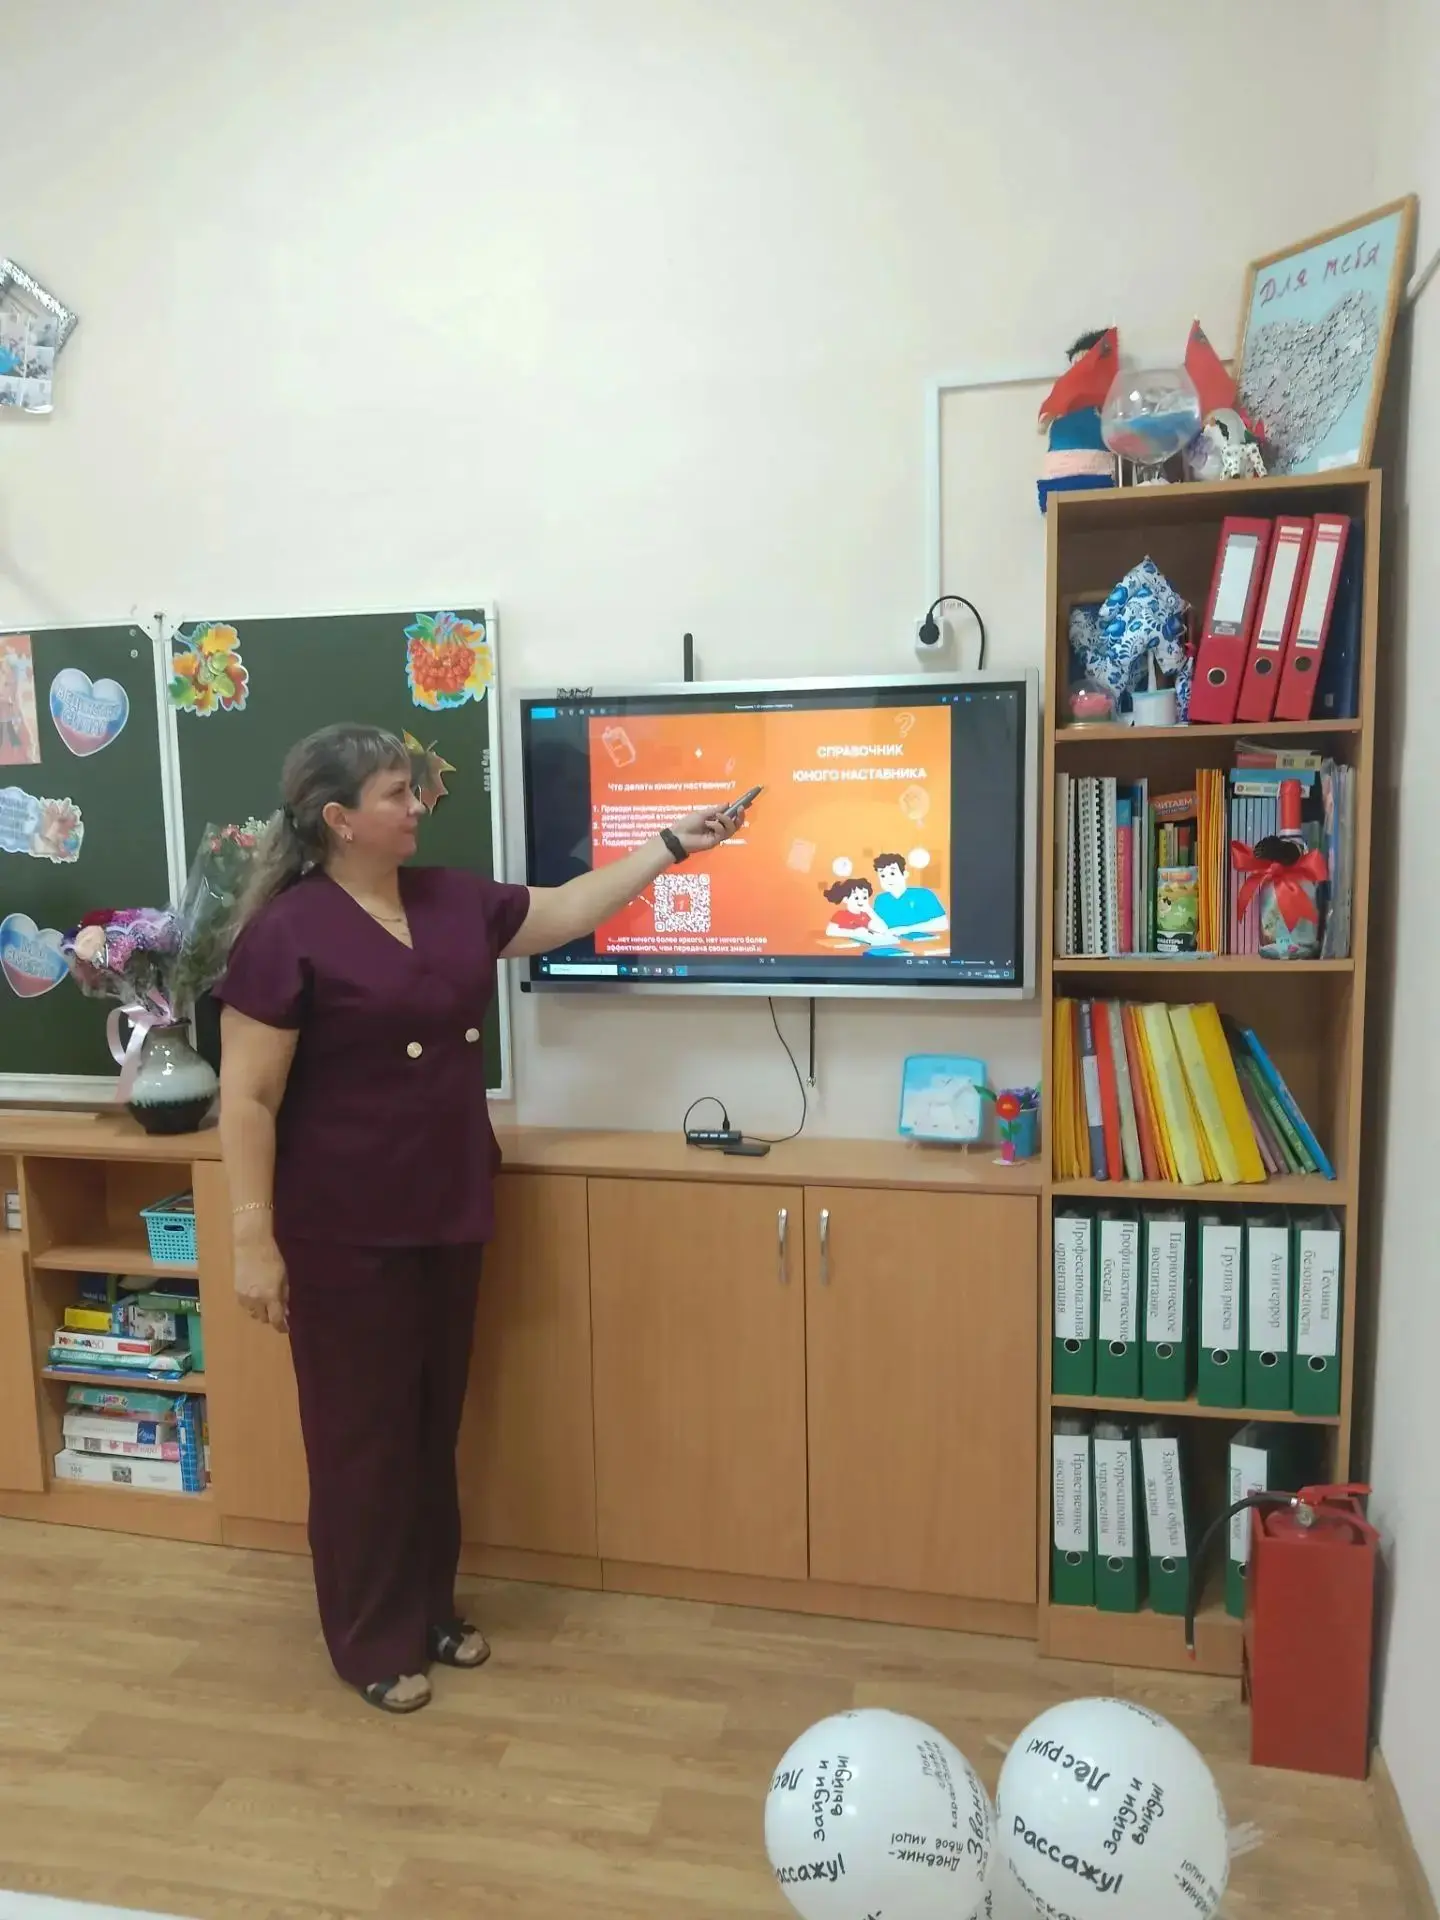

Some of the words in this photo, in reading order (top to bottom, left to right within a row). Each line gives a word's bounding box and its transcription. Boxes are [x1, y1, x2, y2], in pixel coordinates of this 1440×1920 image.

[792, 769, 839, 782] ЮНОГО
[841, 767, 928, 781] НАСТАВНИКА
[816, 744, 904, 758] СПРАВОЧНИК
[608, 782, 623, 792] Что
[624, 782, 653, 791] делать
[654, 781, 682, 791] юному
[683, 780, 736, 790] наставнику?
[1055, 1243, 1066, 1313] ориентация
[1072, 1221, 1088, 1340] Профессиональная
[1102, 1258, 1115, 1303] беседы
[1119, 1223, 1134, 1341] Профилактические
[1149, 1247, 1161, 1318] воспитание
[1167, 1232, 1182, 1332] Патриотическое
[1220, 1246, 1237, 1292] Группа
[1268, 1253, 1283, 1328] Антитеррор
[1299, 1250, 1316, 1336] безопасности
[1320, 1269, 1335, 1321] Техника
[1221, 1294, 1233, 1331] риска
[1071, 1453, 1086, 1535] Нравственное
[1026, 1738, 1064, 1762] рук!
[831, 1755, 853, 1817] выйди!
[1131, 1783, 1165, 1846] выйди!
[890, 1832, 927, 1845] лицо!
[1013, 1815, 1124, 1895] Рассажу!
